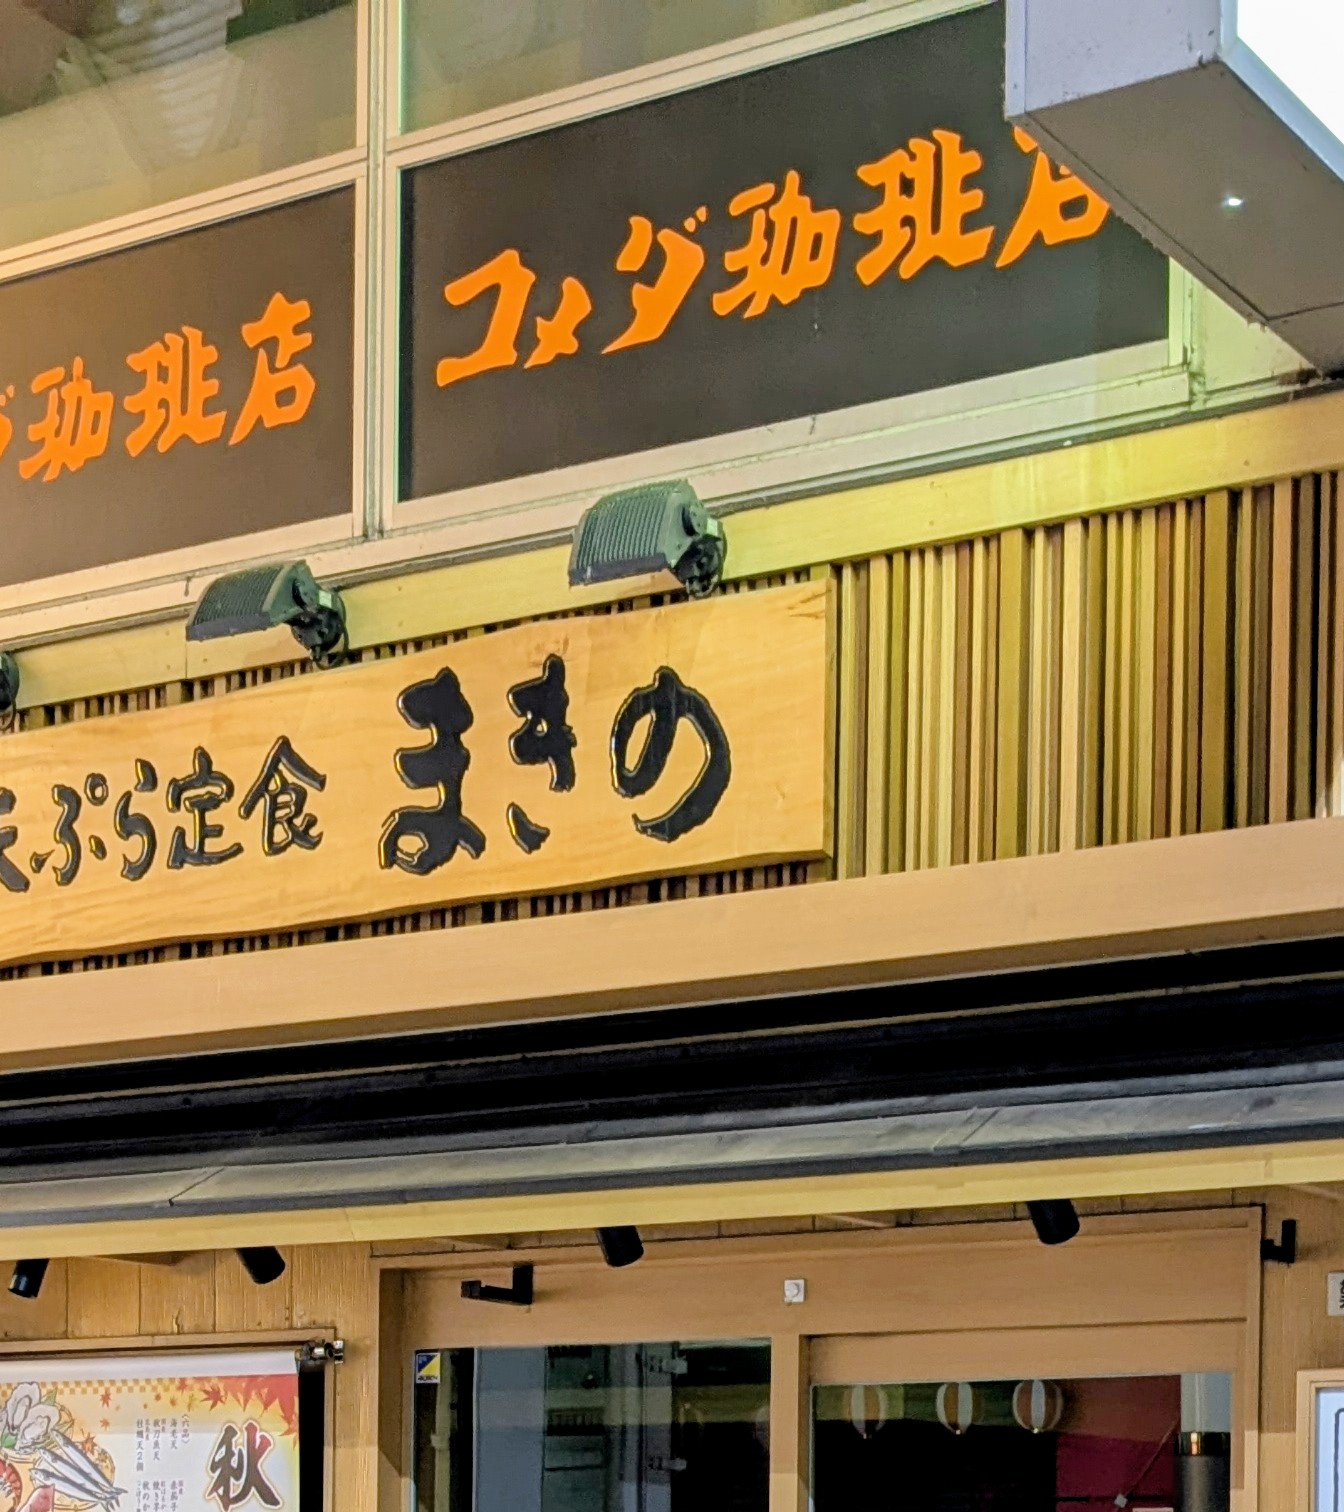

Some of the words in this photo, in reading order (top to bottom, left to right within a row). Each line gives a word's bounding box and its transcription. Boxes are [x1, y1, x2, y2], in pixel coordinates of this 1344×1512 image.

[434, 124, 1110, 389] コメダ珈琲店
[378, 653, 734, 875] まきの
